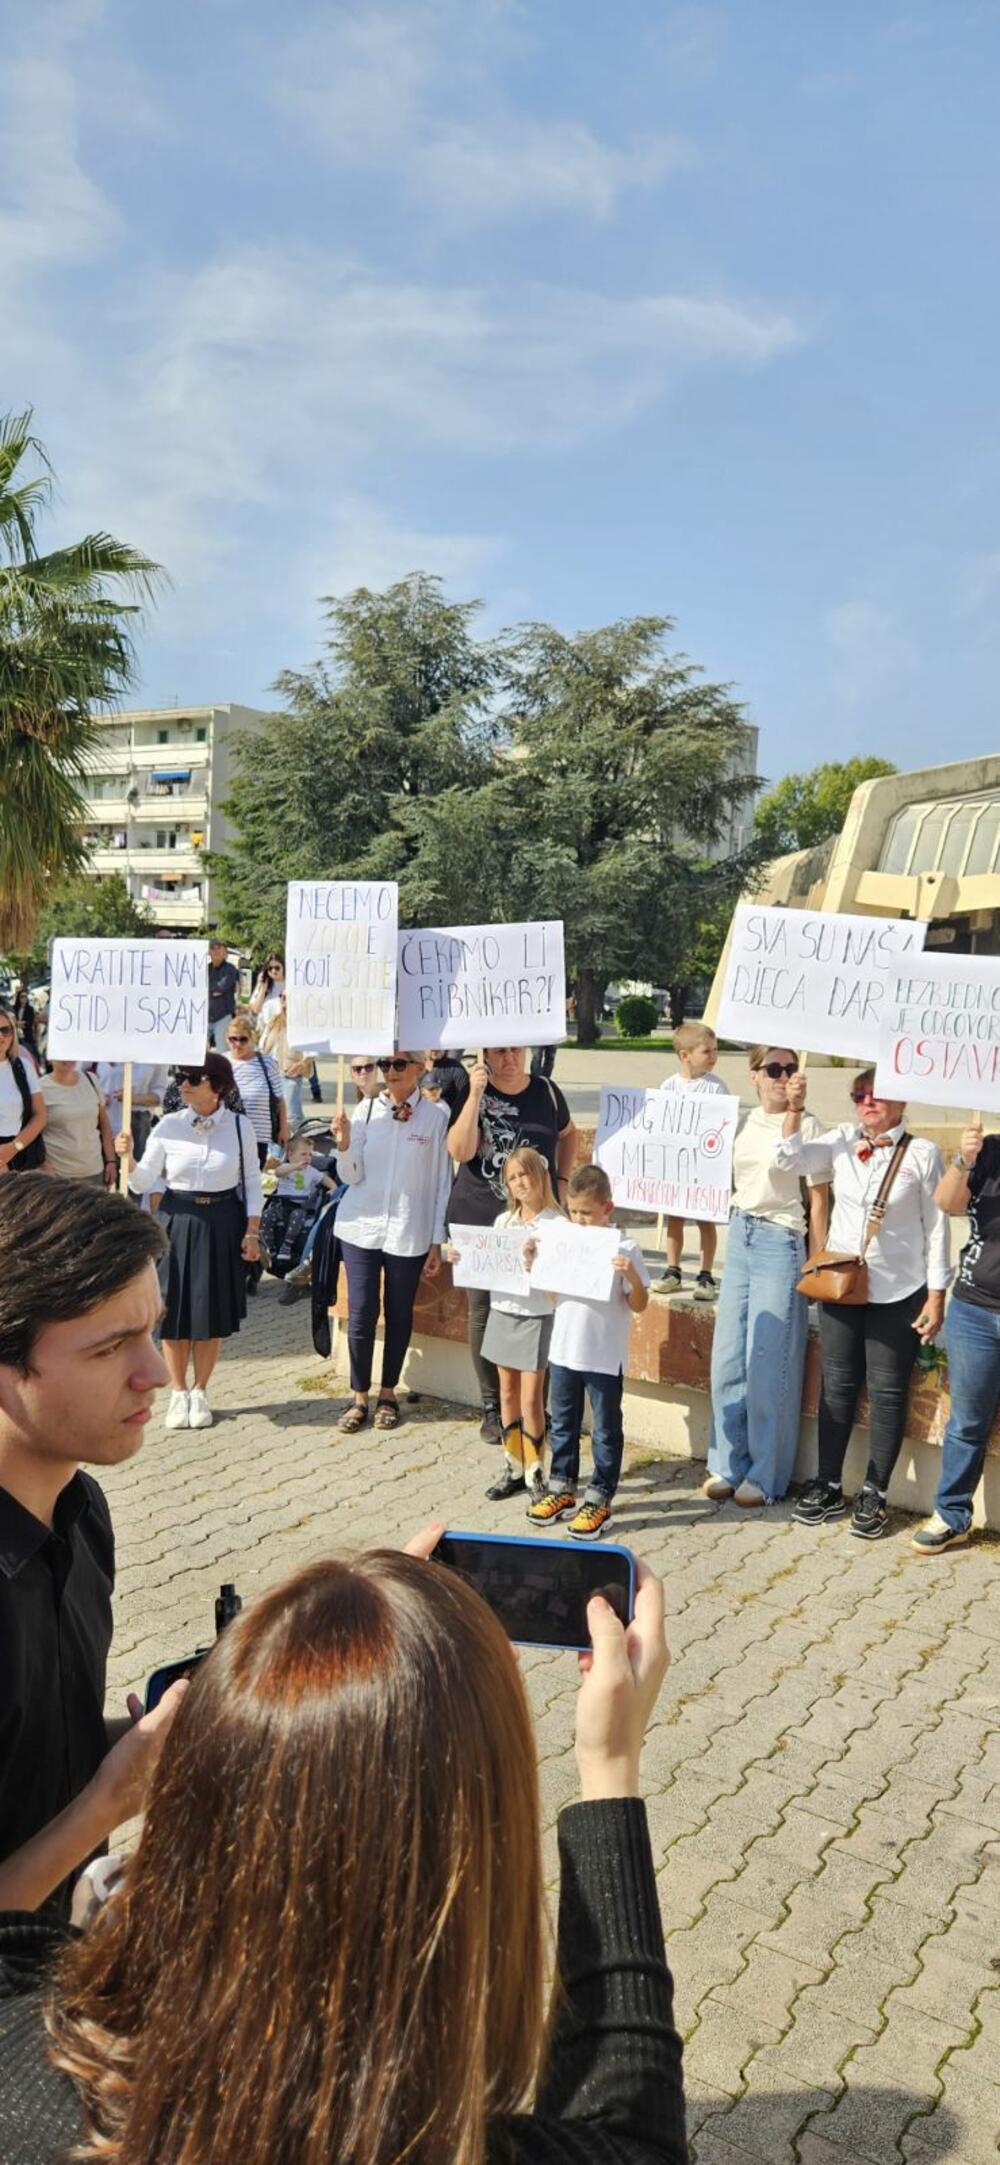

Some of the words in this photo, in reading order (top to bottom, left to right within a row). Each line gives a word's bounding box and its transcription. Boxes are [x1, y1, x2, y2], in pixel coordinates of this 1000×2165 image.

[401, 936, 500, 977] ČEKAMO
[746, 915, 788, 960] SVA
[798, 921, 836, 963] SU
[60, 949, 154, 986] VRATITE
[164, 951, 208, 987] NAM
[55, 993, 110, 1032] STID
[123, 995, 128, 1033] I
[135, 996, 207, 1034] SRAM
[889, 1007, 913, 1033] JE
[604, 1094, 656, 1134] DRUG
